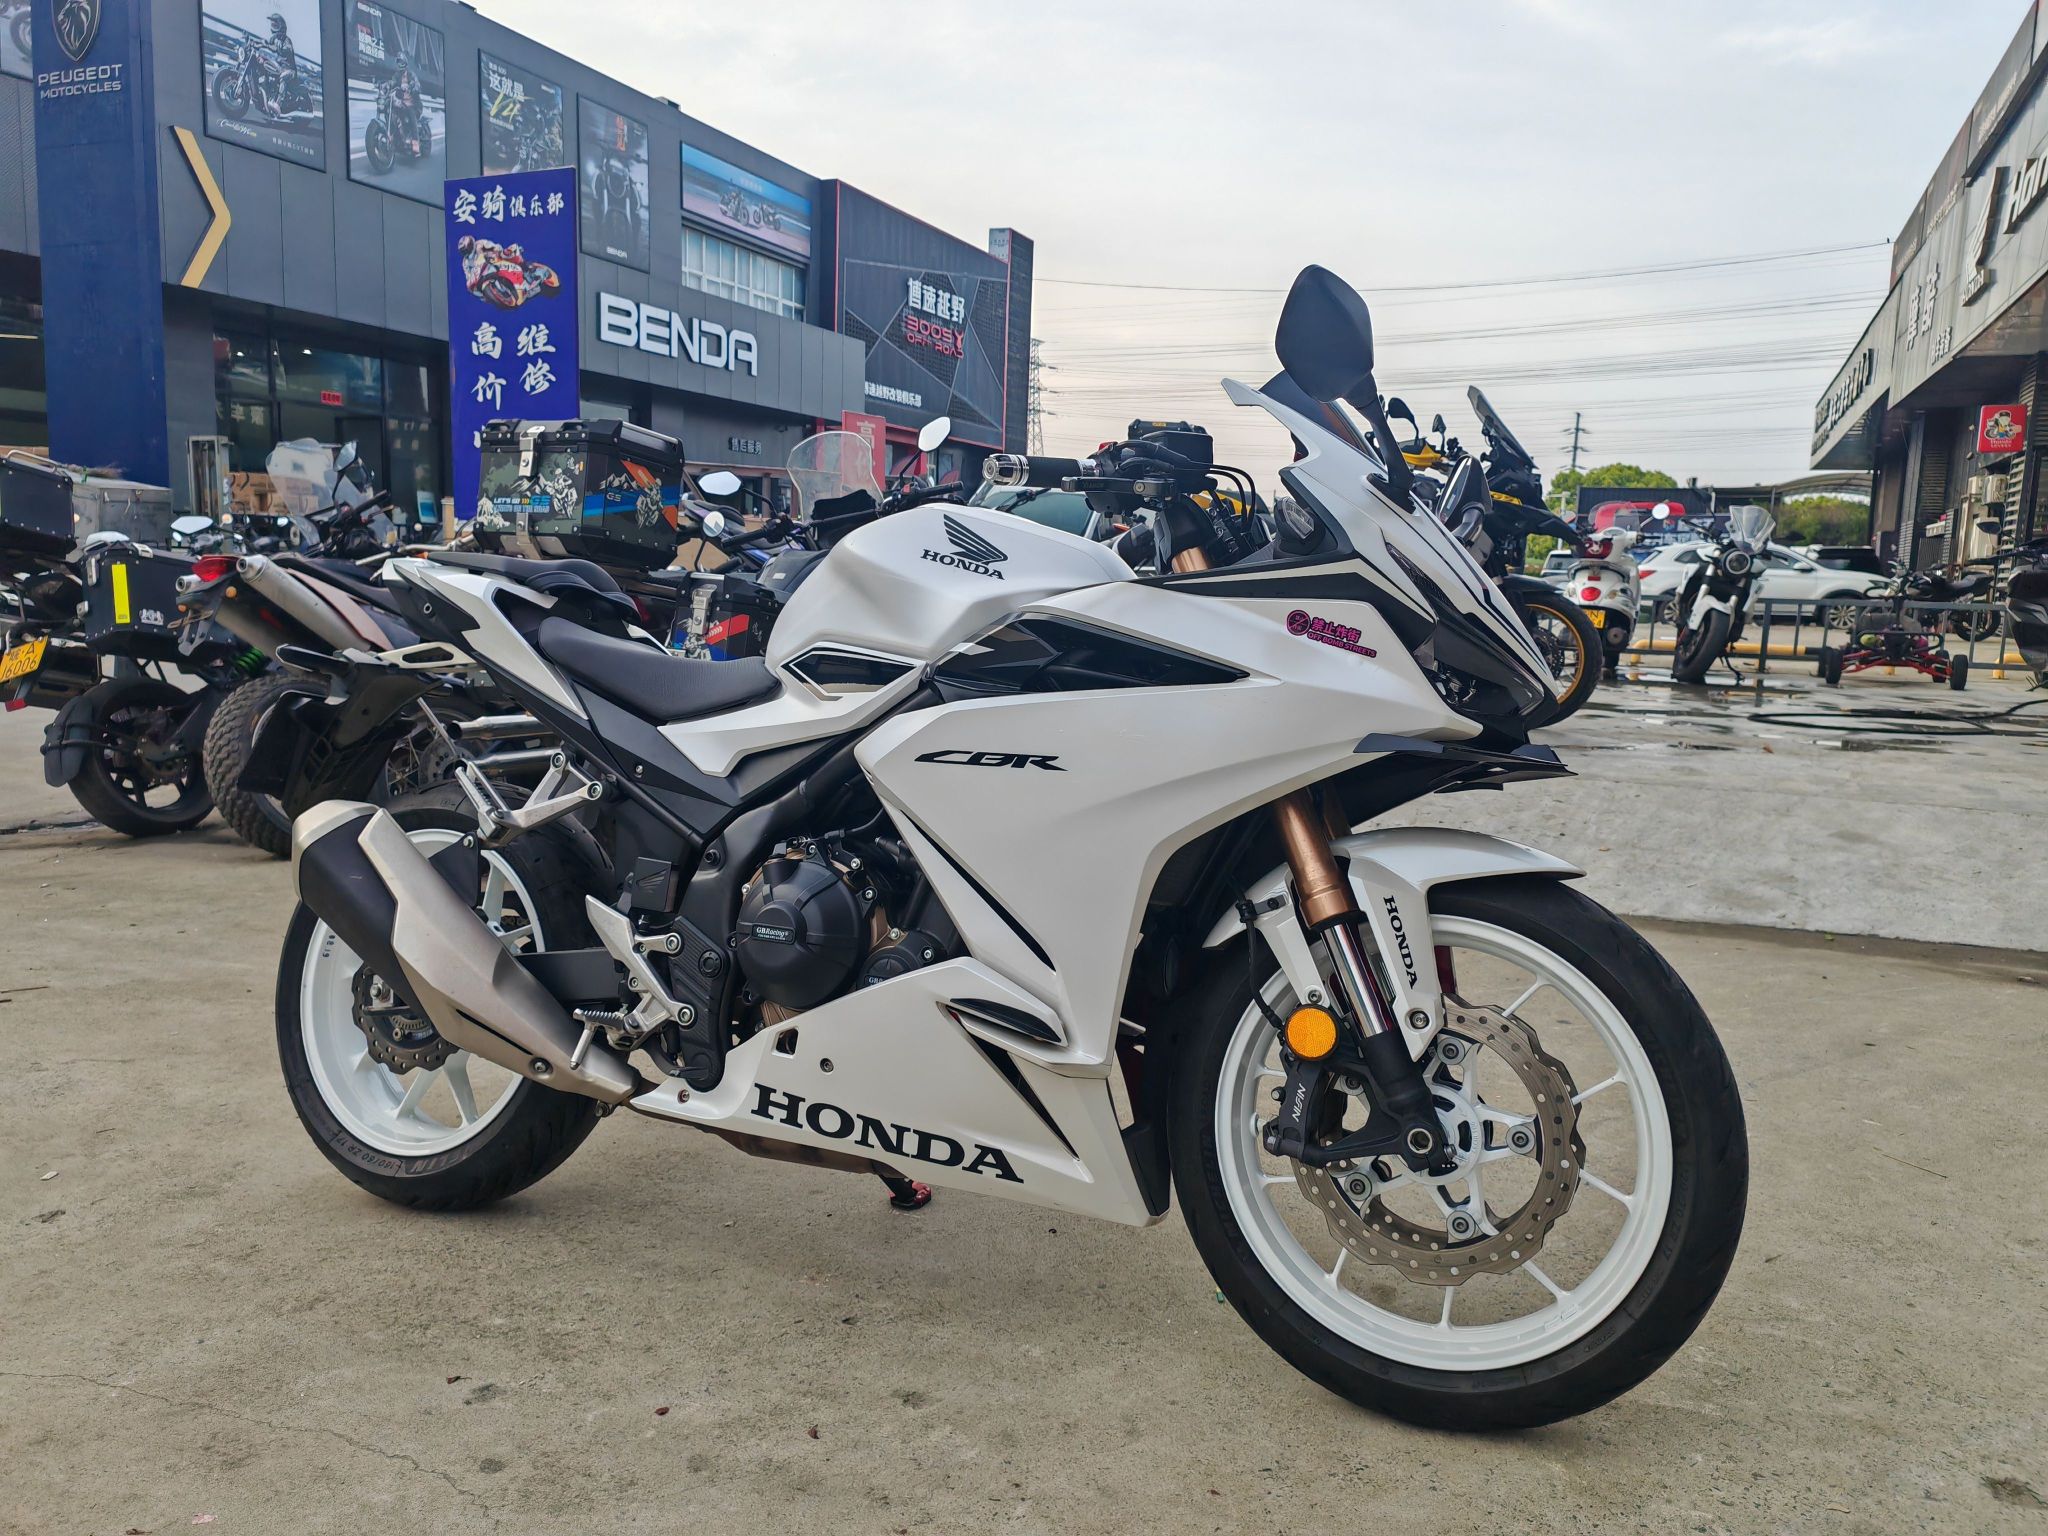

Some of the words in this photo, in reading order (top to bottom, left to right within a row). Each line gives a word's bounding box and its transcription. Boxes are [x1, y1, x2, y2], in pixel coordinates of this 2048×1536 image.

[38, 64, 123, 87] PEUGEOT
[41, 81, 122, 99] MOTOCYCLES
[488, 70, 525, 103] 这就是
[453, 184, 565, 225] 安骑俱乐部
[907, 277, 965, 325] 博速越野
[600, 291, 758, 377] BENDA
[516, 323, 557, 396] 维修
[920, 548, 1005, 580] HONDA
[1311, 617, 1361, 643] 禁止炸街
[1322, 637, 1344, 648] BOMB
[1344, 642, 1377, 658] STREETS
[914, 749, 1068, 772] CBR
[1383, 895, 1418, 990] HONDA
[751, 1082, 1024, 1184] HONDA
